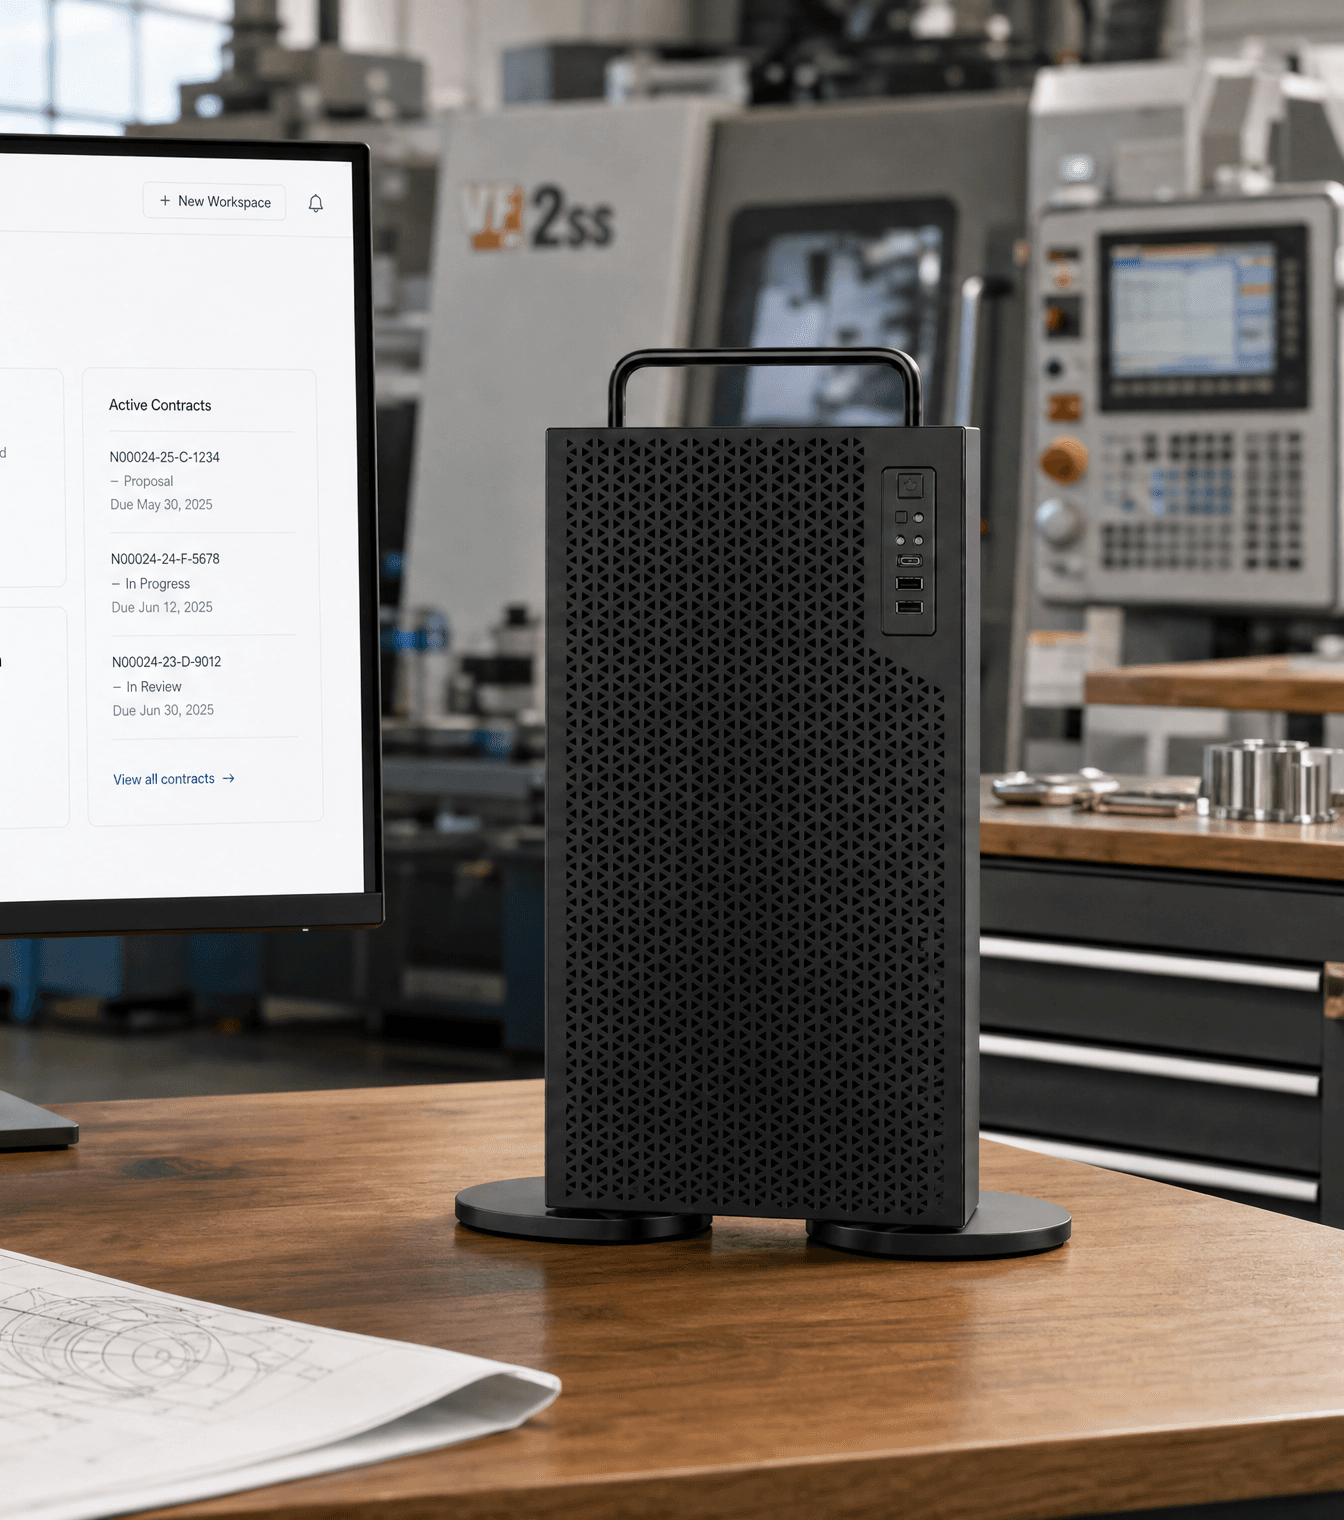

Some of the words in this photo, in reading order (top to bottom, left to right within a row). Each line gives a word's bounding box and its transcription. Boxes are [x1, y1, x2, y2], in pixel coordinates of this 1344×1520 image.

[178, 194, 205, 207] New
[207, 195, 272, 211] Workspace
[108, 398, 148, 412] Active
[150, 398, 212, 412] Contracts
[109, 450, 221, 464] N00024-25-C-1234
[124, 474, 174, 490] Proposal
[110, 498, 134, 511] Due
[136, 498, 162, 514] May
[163, 498, 182, 513] 30,
[184, 498, 213, 511] 2025
[111, 552, 220, 565] N00024-24-F-5678
[125, 577, 137, 590] In
[140, 577, 191, 593] Progress
[111, 600, 136, 614] Due
[138, 600, 160, 614] Jun
[163, 600, 181, 615] 12,
[183, 600, 214, 614] 2025
[112, 655, 222, 669] N00024-23-D-9012
[126, 680, 138, 693] In
[140, 680, 183, 693] Review
[112, 704, 137, 717] Due
[139, 704, 161, 717] Jun
[164, 703, 182, 718] 30,
[185, 703, 215, 716] 2025
[112, 773, 143, 786] View
[144, 772, 158, 786] all
[160, 772, 216, 785] contracts
